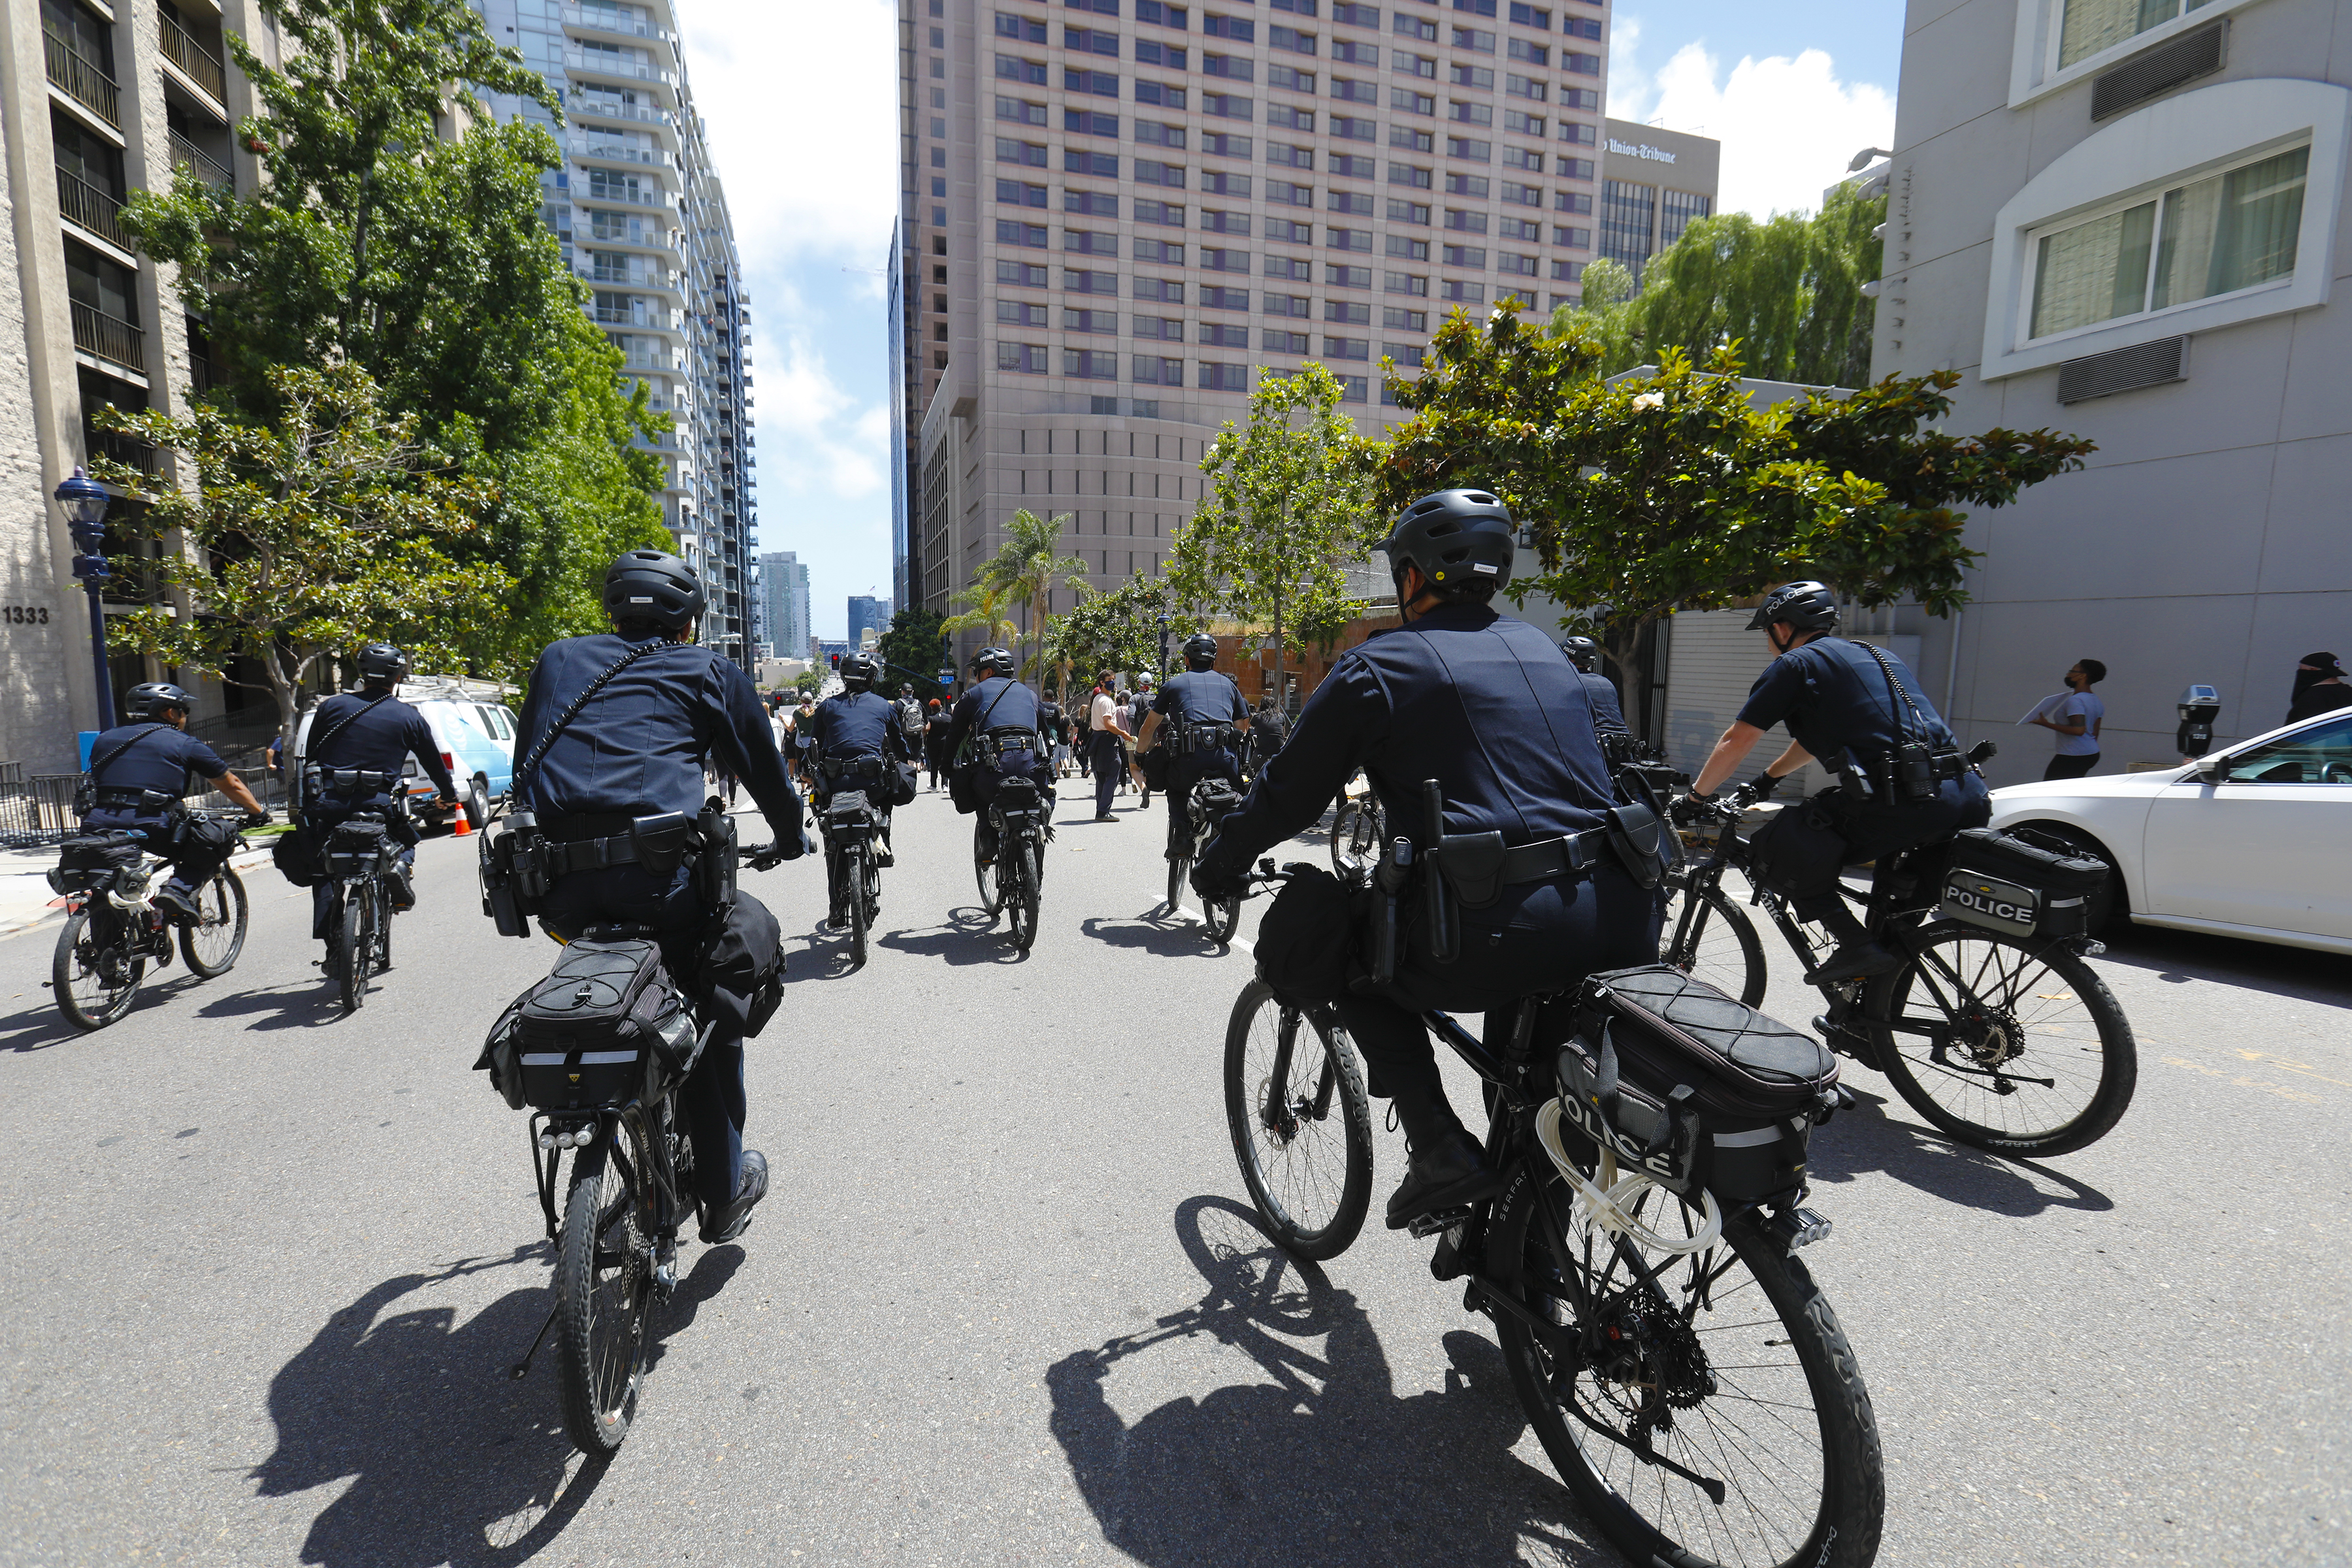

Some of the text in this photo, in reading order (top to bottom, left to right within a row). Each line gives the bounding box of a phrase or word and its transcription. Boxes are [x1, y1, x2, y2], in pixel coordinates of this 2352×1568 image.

[1609, 138, 1676, 164] Union-Tribune
[1766, 588, 1804, 615] POLICE
[3, 606, 49, 625] 1333
[980, 654, 994, 662] POLICE
[1563, 646, 1576, 655] POLICE
[1946, 885, 2034, 923] POLICE
[1556, 1075, 1673, 1177] POLICE
[1987, 1139, 2038, 1148] SERFAS
